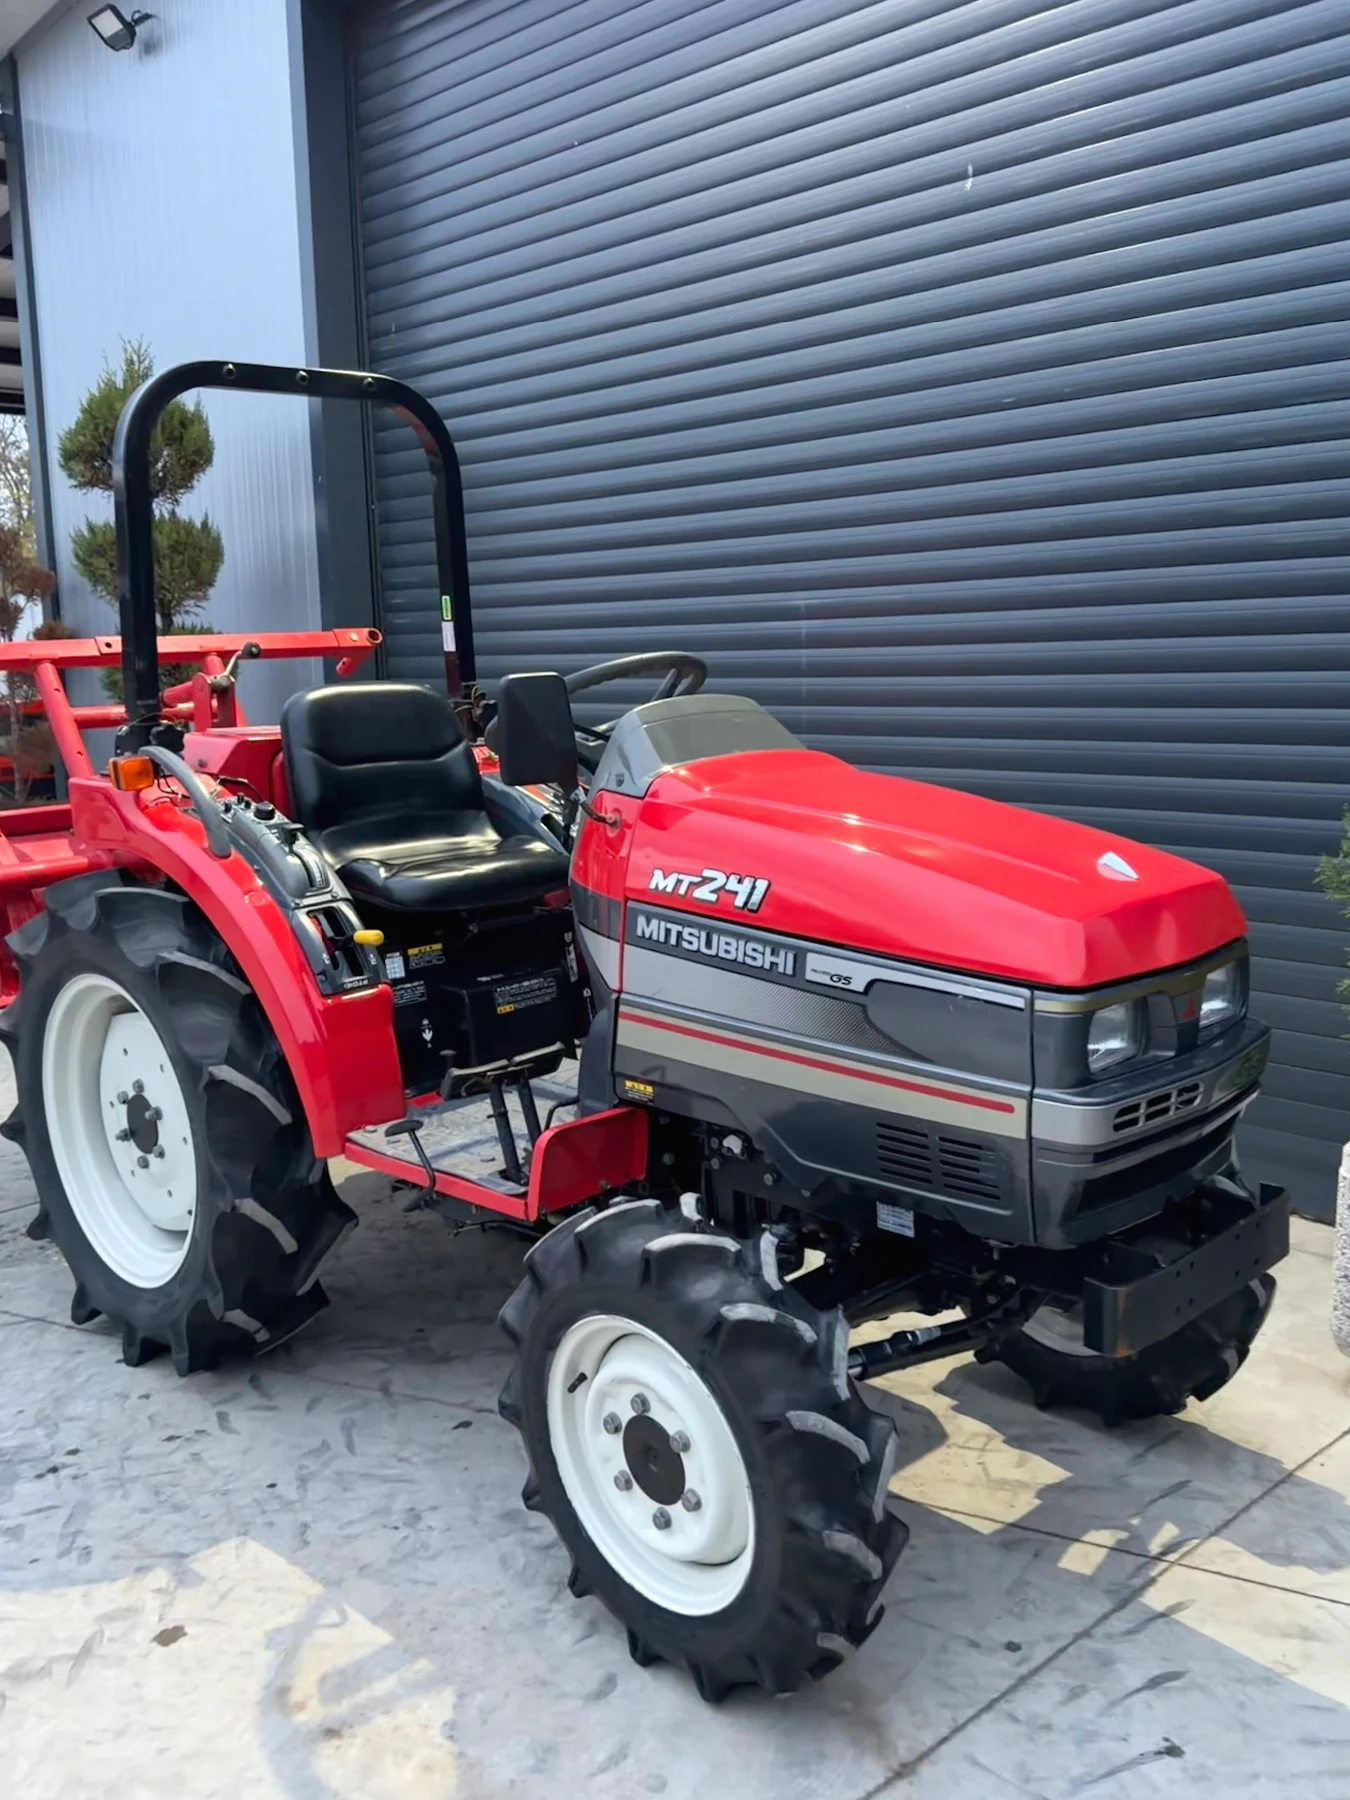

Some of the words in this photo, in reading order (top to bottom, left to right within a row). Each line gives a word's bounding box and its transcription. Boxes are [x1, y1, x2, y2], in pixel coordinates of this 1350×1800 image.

[649, 868, 771, 912] MT241
[636, 915, 797, 976] MITSUBISHI
[830, 974, 853, 985] GS
